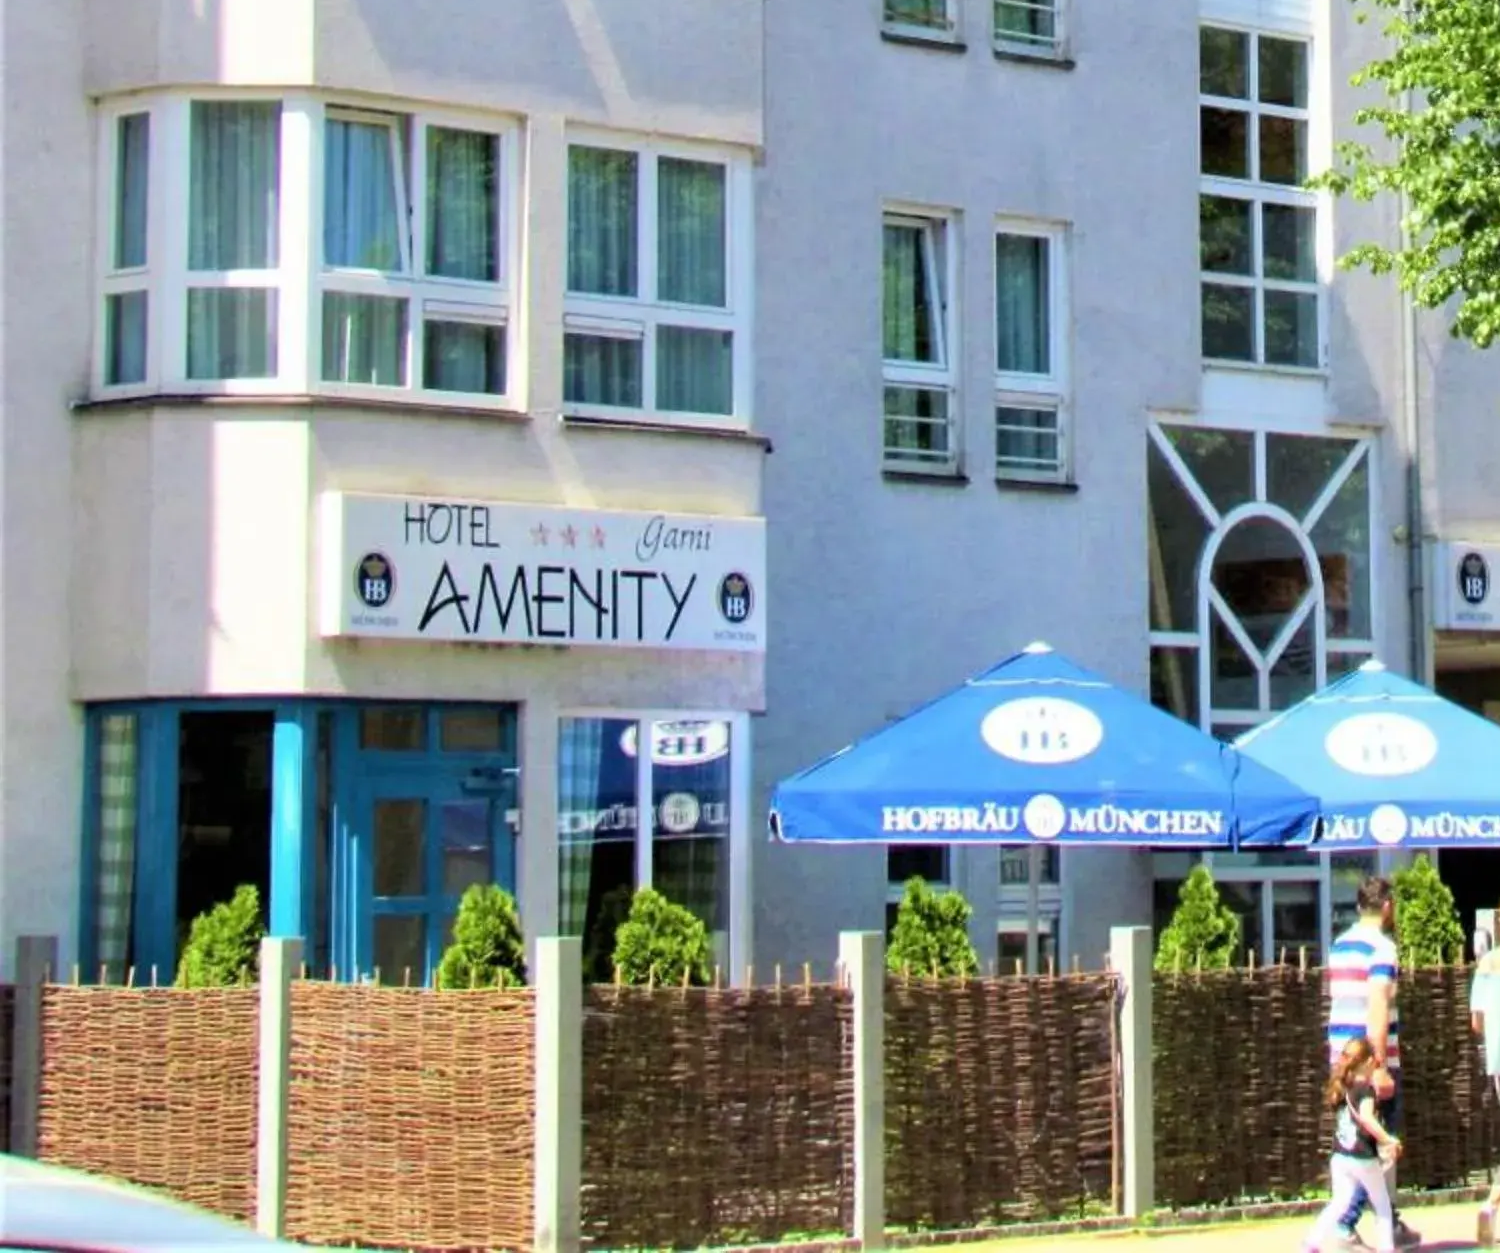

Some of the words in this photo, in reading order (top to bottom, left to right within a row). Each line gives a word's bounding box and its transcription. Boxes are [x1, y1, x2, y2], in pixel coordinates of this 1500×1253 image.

[404, 502, 500, 548] HOTEL
[417, 560, 698, 641] AMENITY
[882, 801, 1020, 832] HOFBRÄU
[1069, 803, 1223, 835] MÜNCHEN
